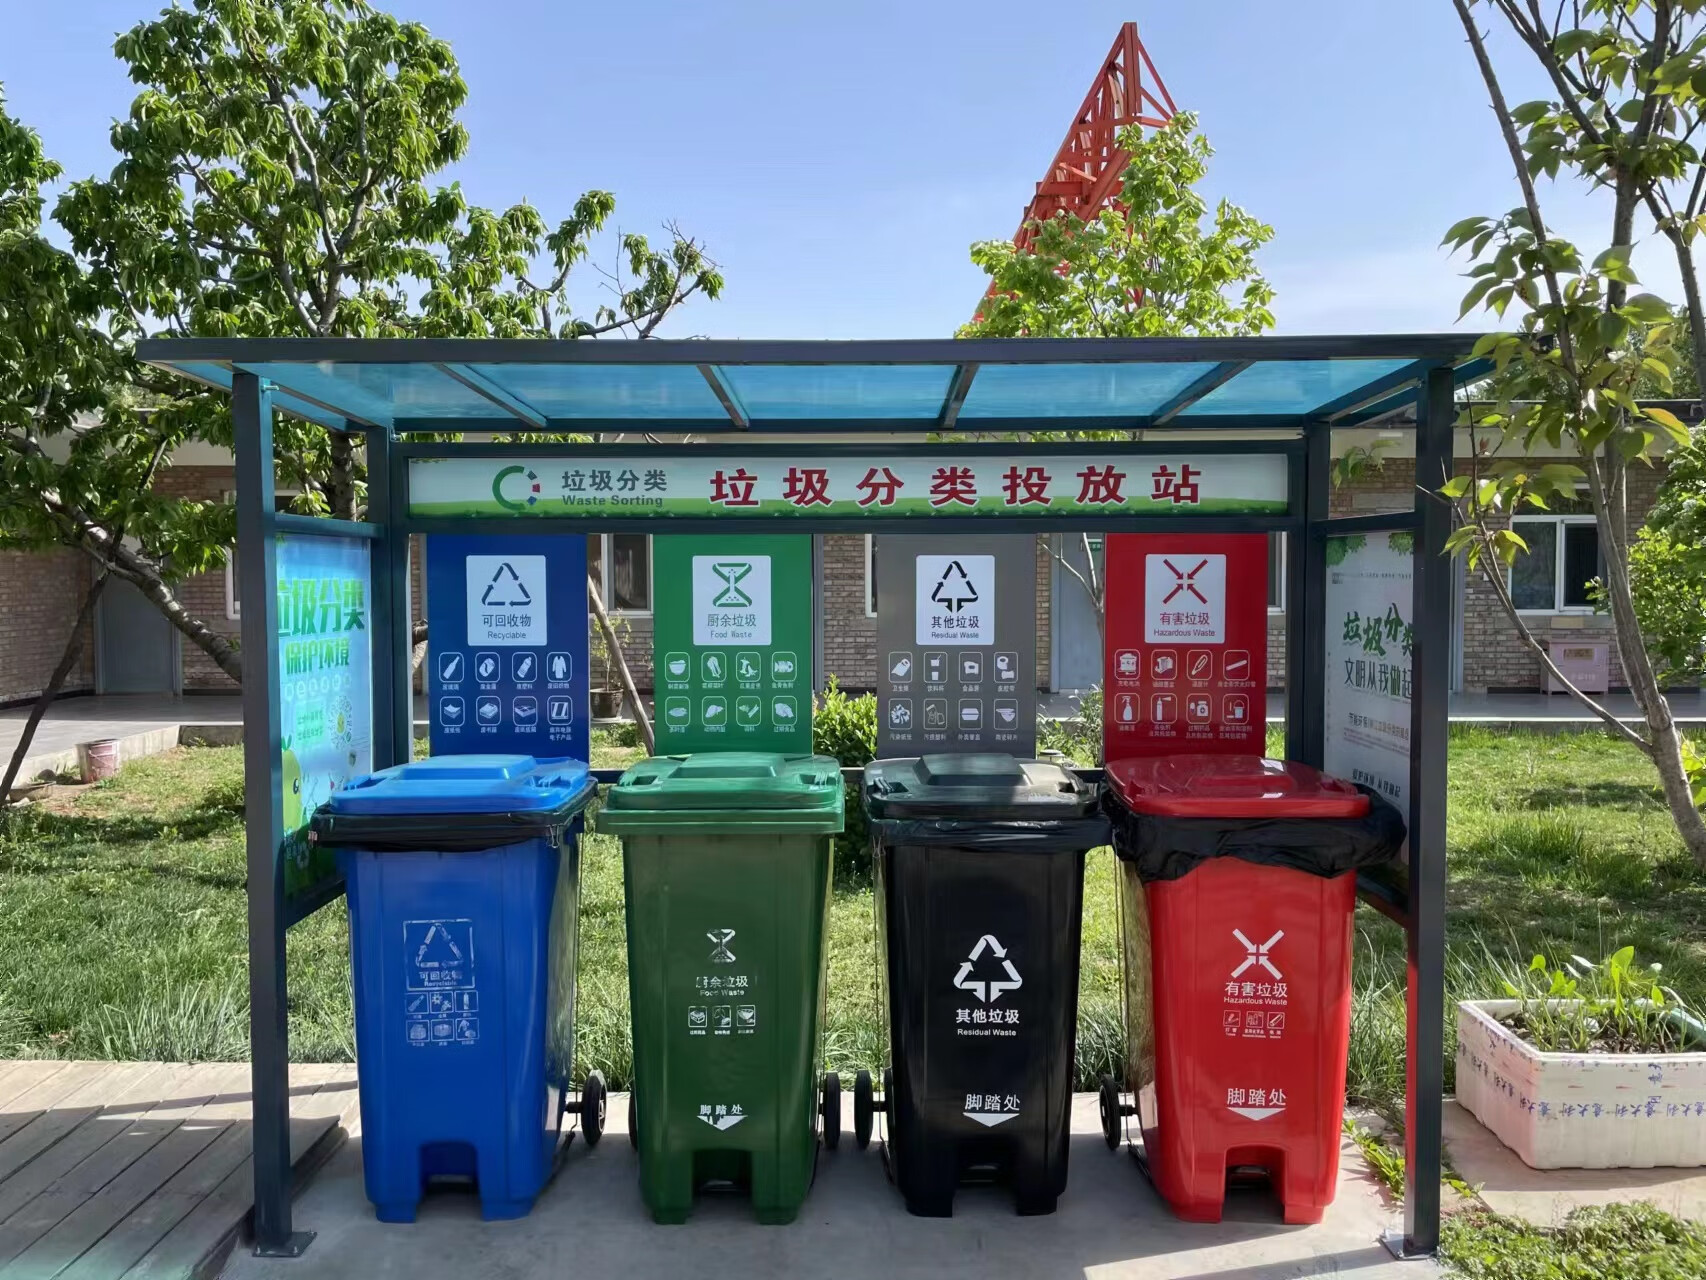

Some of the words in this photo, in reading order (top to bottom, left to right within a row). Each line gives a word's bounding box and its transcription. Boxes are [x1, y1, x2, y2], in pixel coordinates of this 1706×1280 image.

[561, 469, 667, 491] 垃圾分类
[709, 466, 1202, 506] 垃圾分类投放站
[562, 495, 606, 505] Waste
[611, 495, 663, 507] Sorting
[482, 614, 532, 627] 可回收物
[707, 614, 757, 627] 厨余垃圾
[931, 615, 980, 629] 其他垃圾
[1159, 612, 1210, 625] 有害垃圾
[487, 631, 526, 640] Recyclable
[710, 630, 728, 638] Food
[731, 630, 752, 638] Waste
[931, 631, 958, 639] Residual
[959, 631, 980, 639] Waste
[1153, 628, 1191, 637] Hazardous
[1193, 628, 1216, 637] Waste
[285, 639, 350, 675] 保护环境
[1224, 981, 1288, 998] 有害垃圾
[1223, 996, 1263, 1005] Hazardous
[1264, 998, 1288, 1006] Waste
[956, 1008, 1020, 1024] 其他垃圾
[957, 1028, 991, 1036] Residual
[992, 1028, 1017, 1036] Waste
[964, 1094, 1020, 1111] 脚踏处
[1227, 1088, 1287, 1106] 脚踏处
[700, 1104, 743, 1116] 脚踏处
